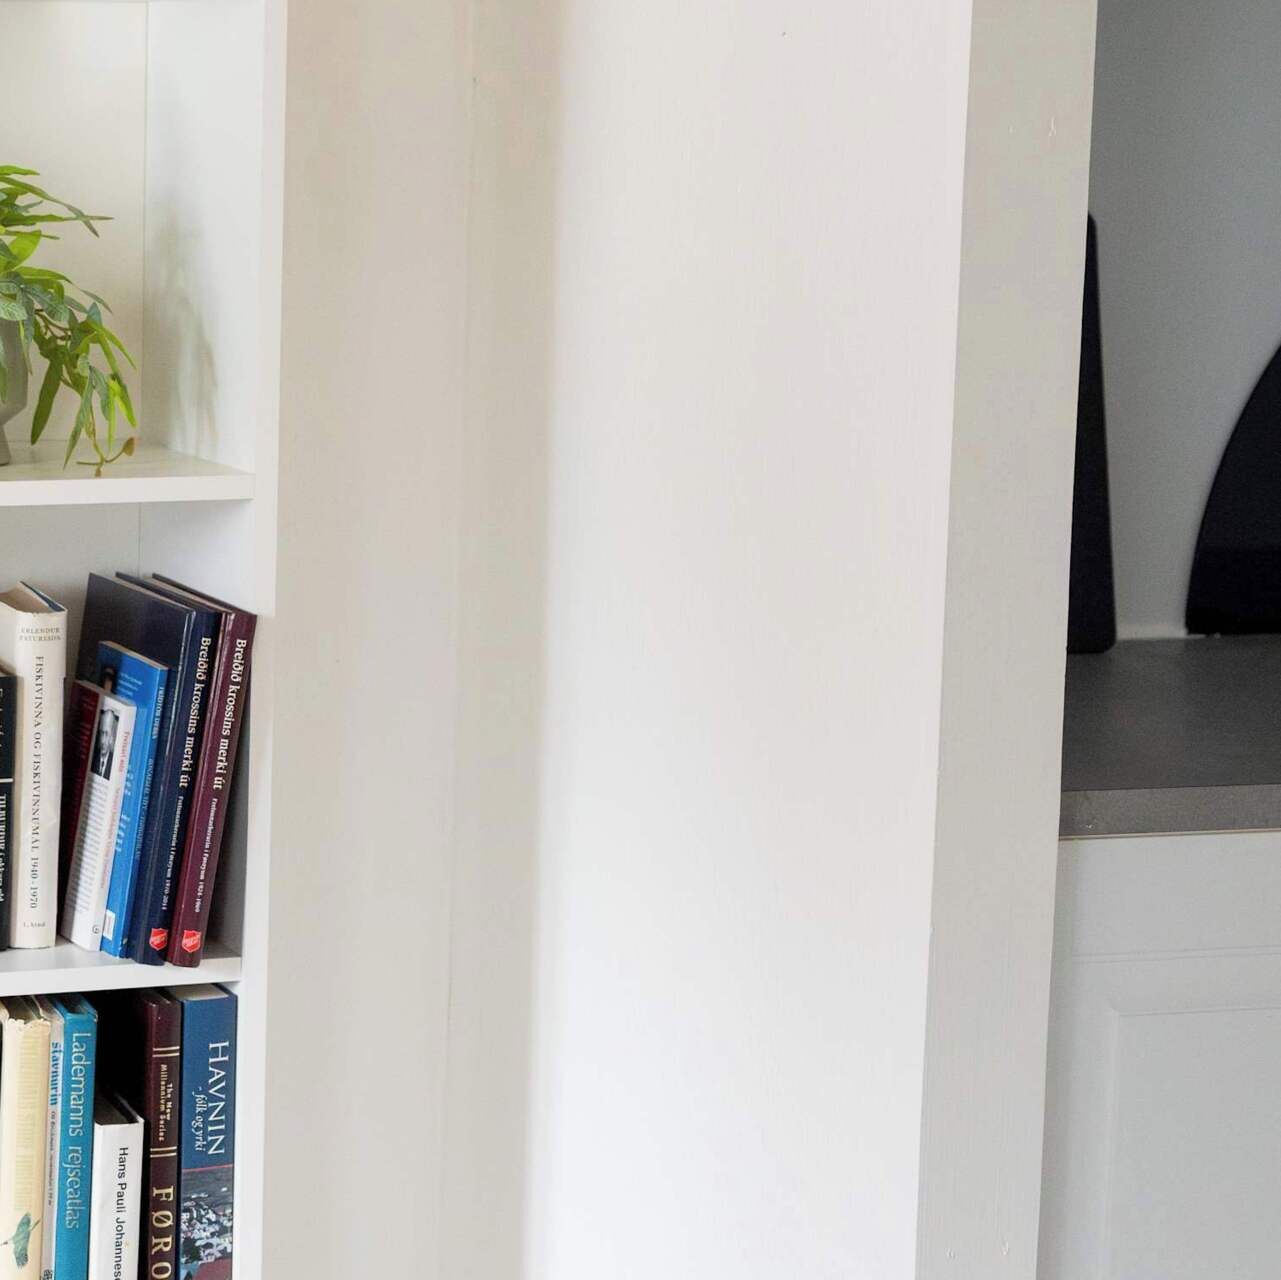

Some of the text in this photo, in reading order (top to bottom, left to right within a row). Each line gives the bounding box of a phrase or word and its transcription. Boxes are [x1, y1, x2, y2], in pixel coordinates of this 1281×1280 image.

[34, 656, 45, 728] FISKIVINNA
[179, 637, 211, 788] Breiðið krossins merki út
[212, 639, 247, 790] Breiðið krossins merki út
[34, 731, 44, 749] OG
[159, 1064, 168, 1112] Millennium
[207, 1041, 229, 1155] HAVNIN
[62, 1032, 91, 1230] Lademanns rejseatlas
[191, 1116, 205, 1128] og
[192, 1129, 206, 1151] yrki
[118, 1147, 129, 1179] Hans
[116, 1183, 128, 1213] Pauli
